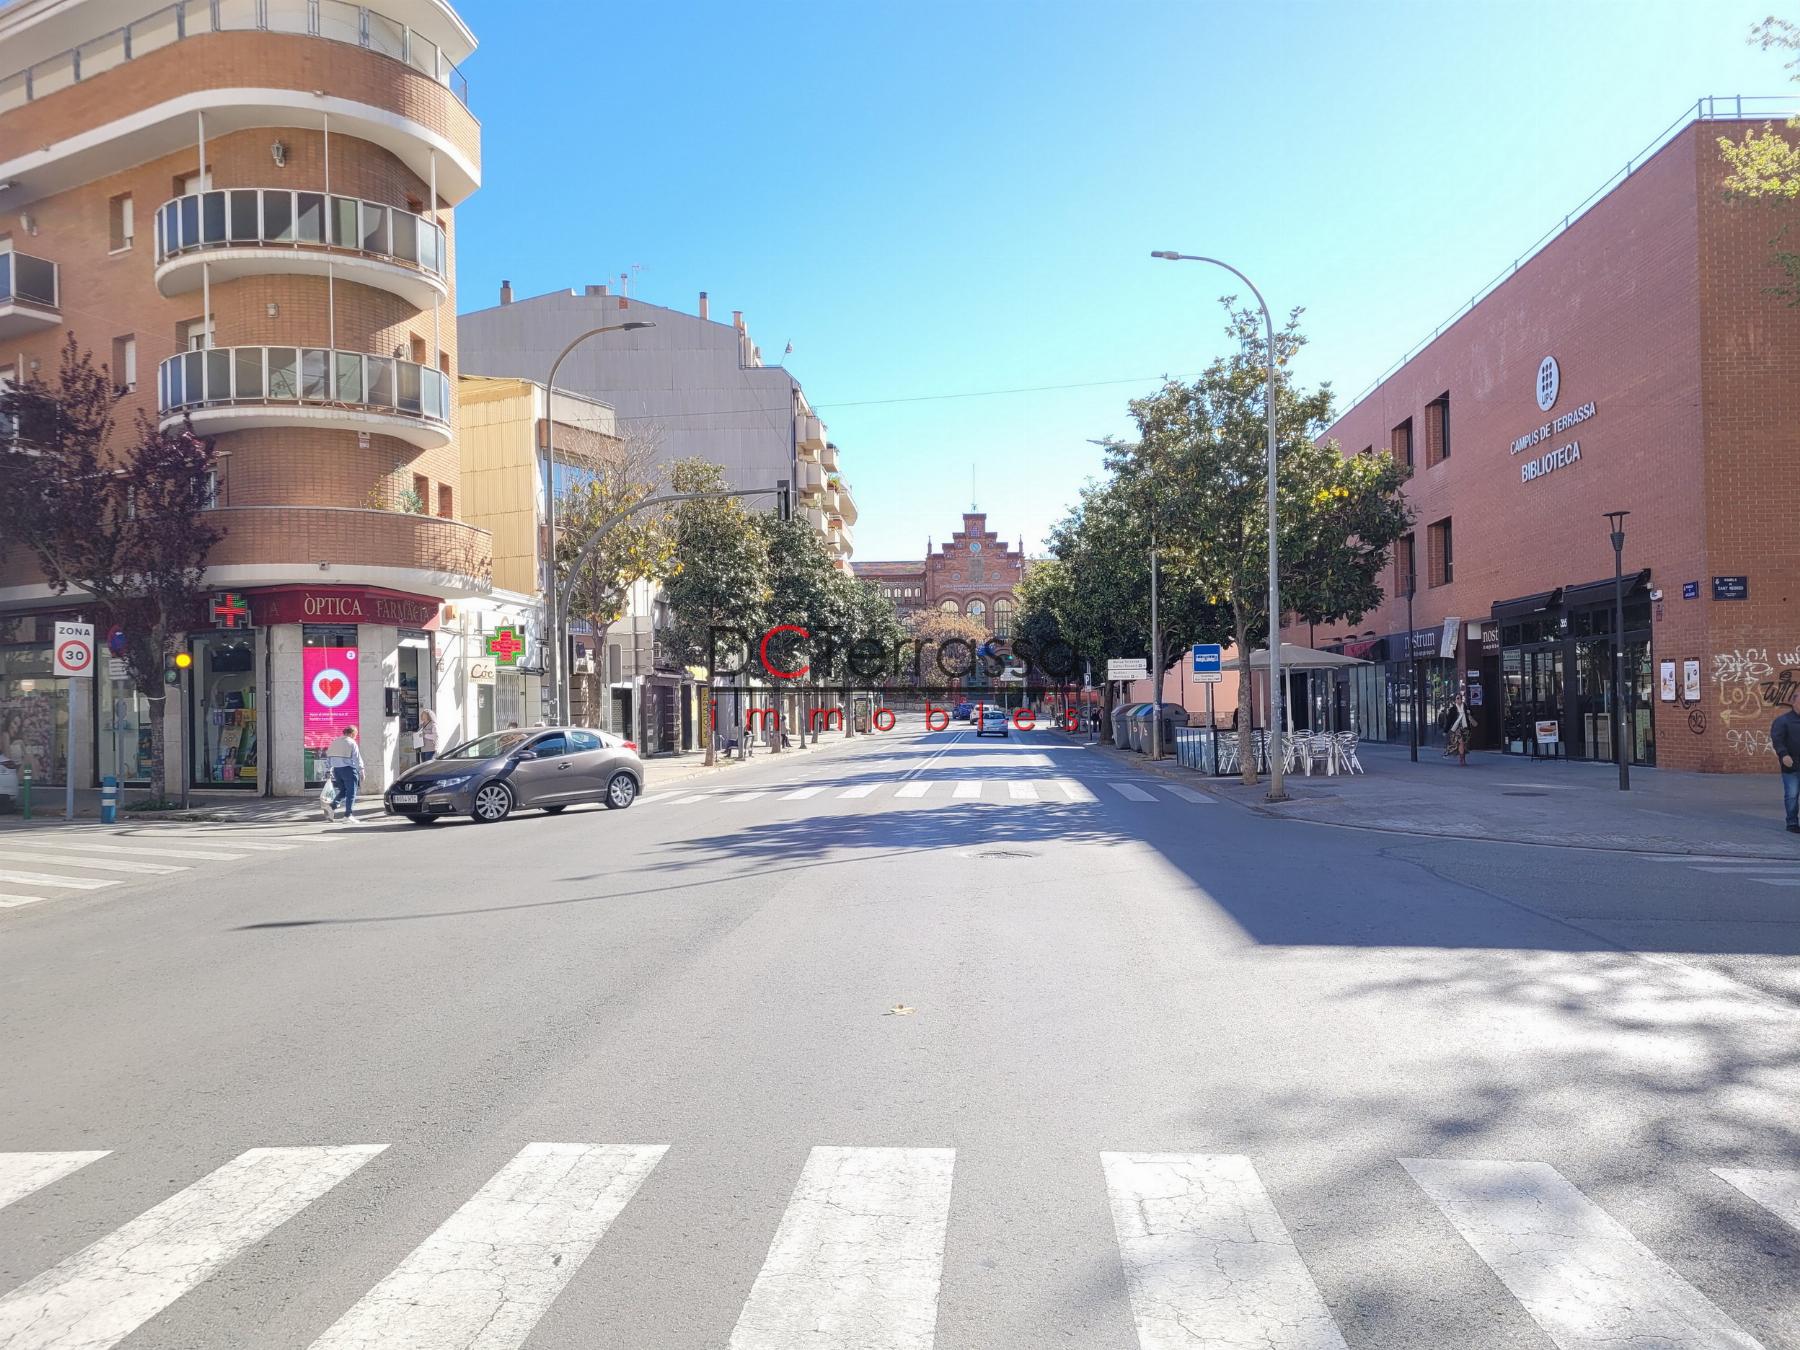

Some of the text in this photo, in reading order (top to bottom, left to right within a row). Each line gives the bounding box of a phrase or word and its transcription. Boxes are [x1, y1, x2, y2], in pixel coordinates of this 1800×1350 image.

[1510, 401, 1597, 455] CAMPUS DE TERRASSA
[1521, 441, 1581, 483] BIBLIOTECA
[304, 593, 363, 616] ÒPTICA
[58, 627, 91, 636] ZONA
[1404, 631, 1436, 650] nstrum
[65, 651, 84, 661] 30
